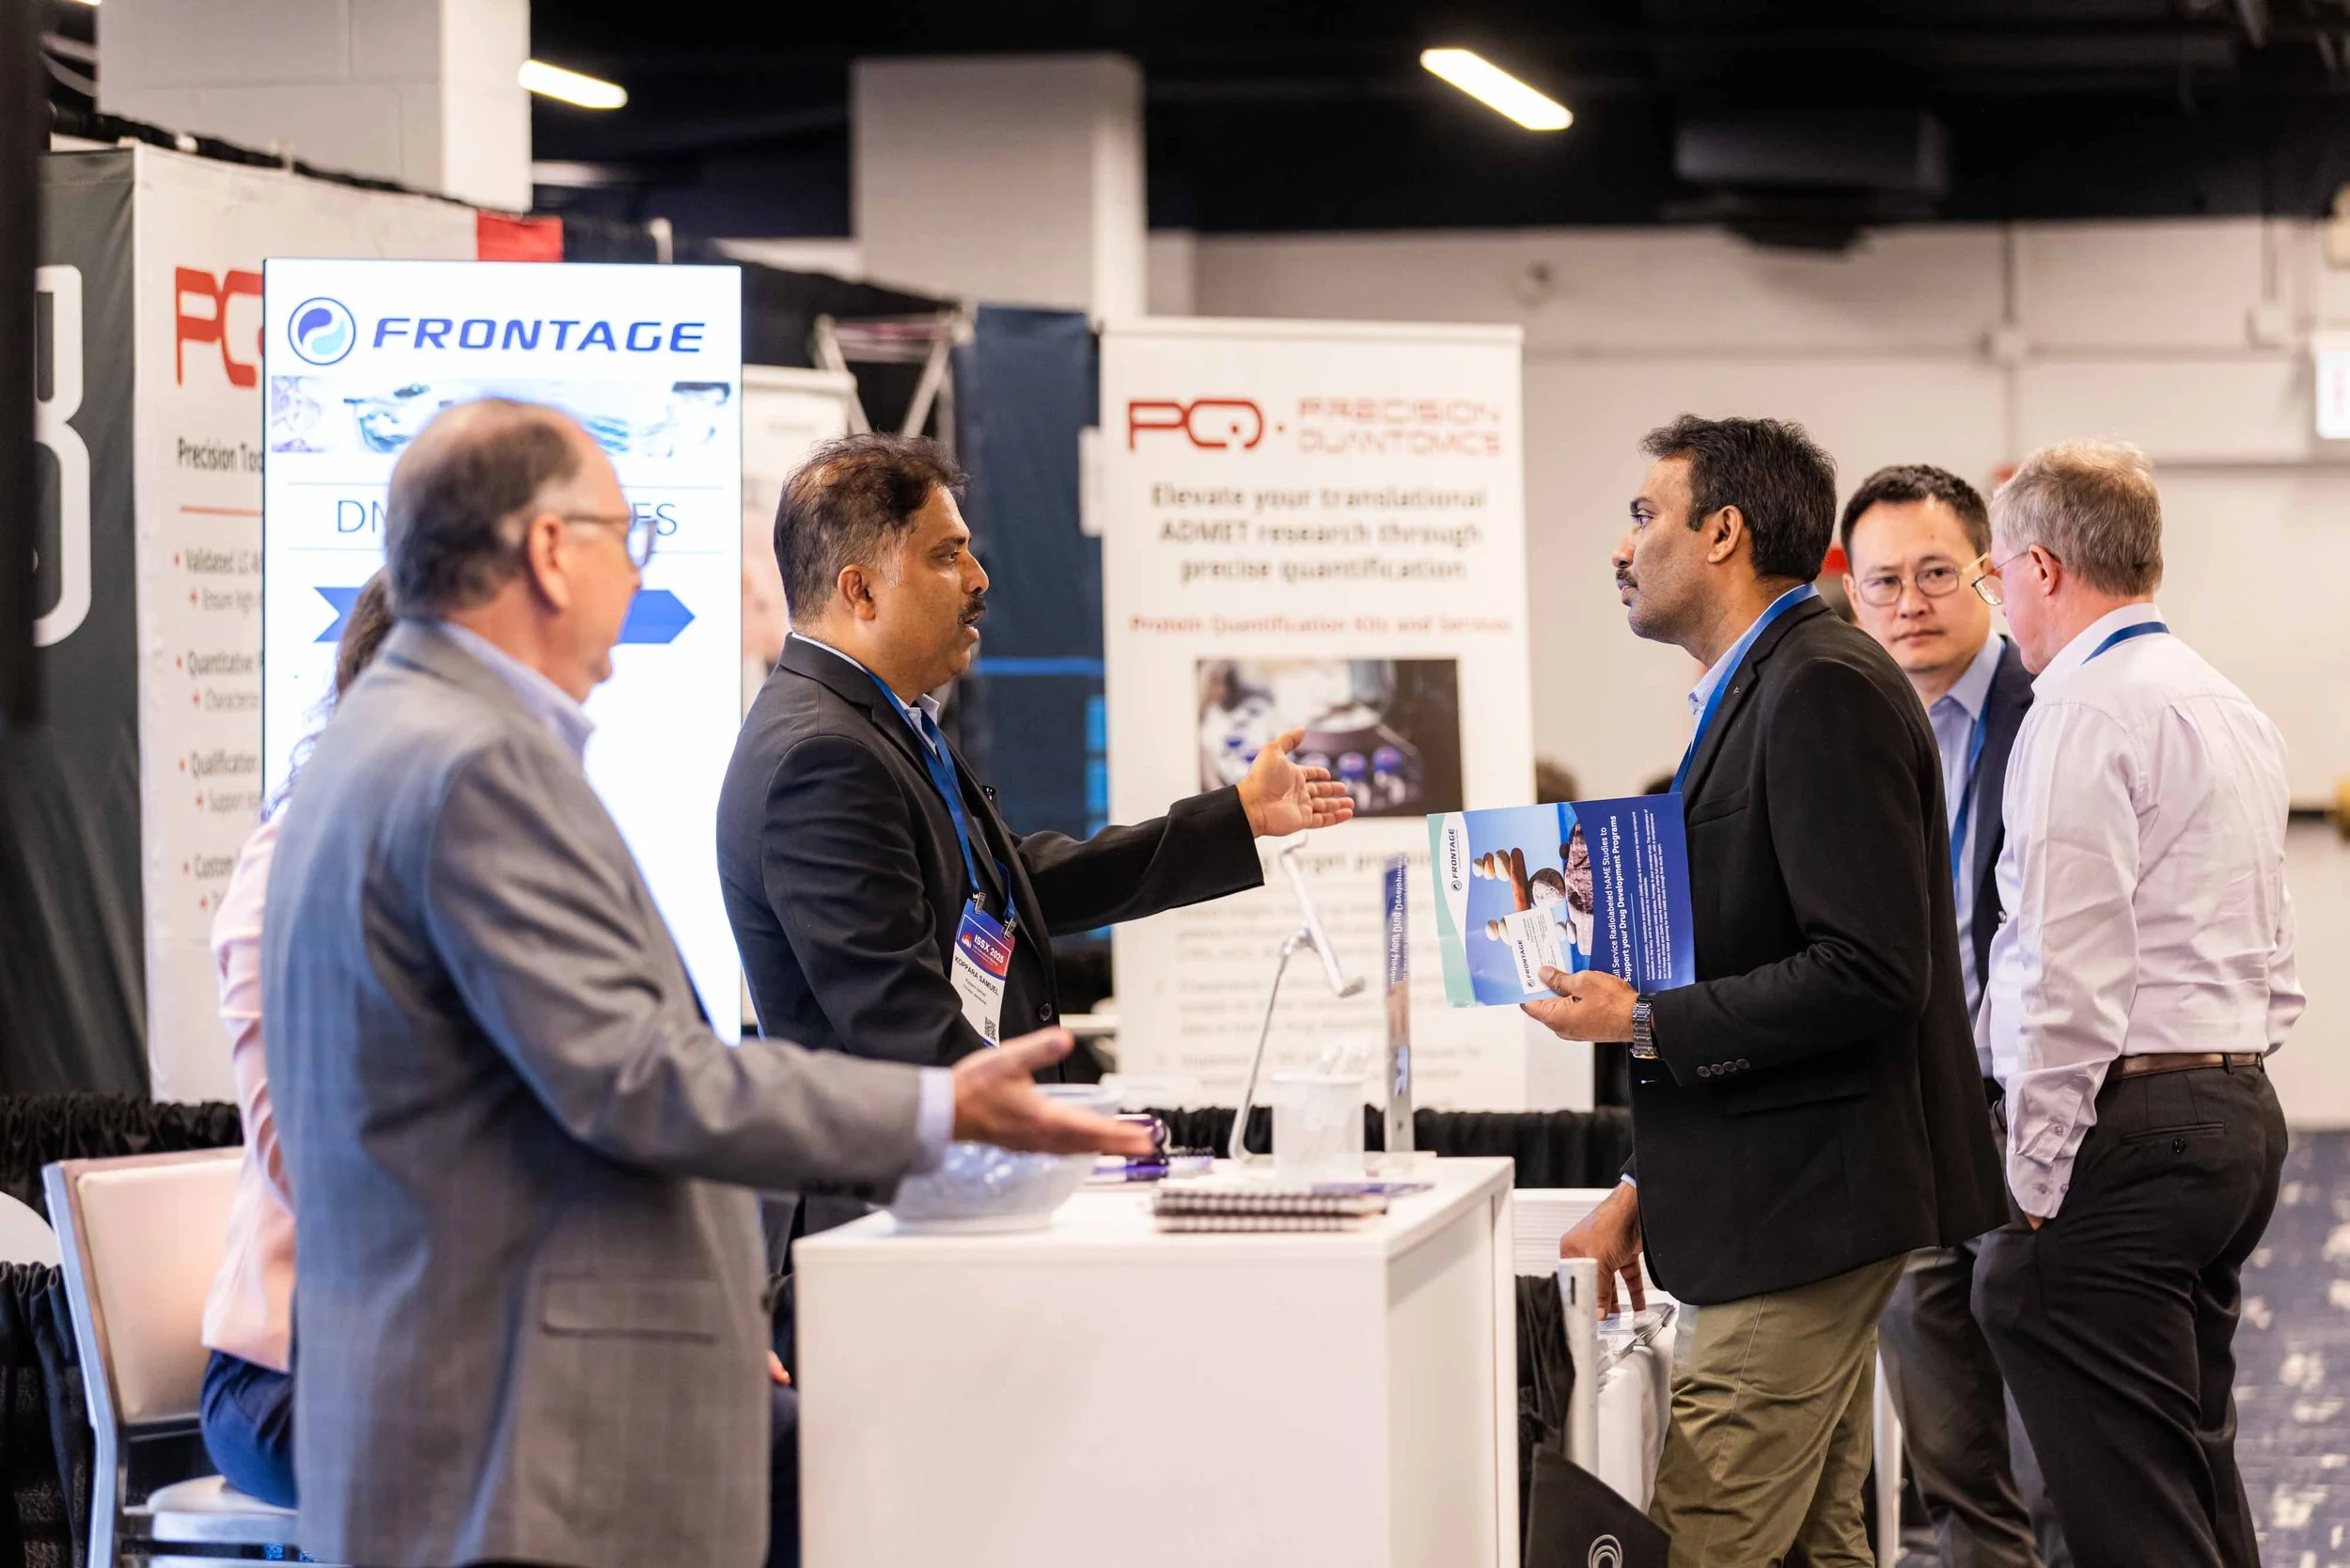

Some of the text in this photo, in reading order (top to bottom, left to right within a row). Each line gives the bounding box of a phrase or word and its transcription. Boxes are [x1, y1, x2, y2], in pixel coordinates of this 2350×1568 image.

[373, 318, 705, 353] FRONTAGE
[1297, 399, 1501, 423] PRECISION
[178, 438, 263, 473] Precision Too
[1151, 483, 1487, 514] Elevate your translational
[1159, 519, 1482, 548] ADMET research through
[1181, 557, 1465, 585] precise quantification
[1211, 617, 1344, 635] Quantification
[1601, 827, 1607, 836] to
[1610, 816, 1620, 854] Programs
[1449, 829, 1458, 878] FRONTAGE
[1602, 838, 1610, 865] Studies
[1604, 867, 1612, 888] hAME
[1613, 856, 1625, 907] Development
[1606, 891, 1617, 939] Radiolabeled
[974, 934, 990, 952] ISSX
[990, 948, 1004, 964] 2025
[1622, 931, 1631, 948] your
[1517, 939, 1531, 979] FRONTAGE
[1622, 950, 1632, 981] Support
[955, 955, 979, 980] KOPPARA
[979, 976, 998, 996] SAMUEL
